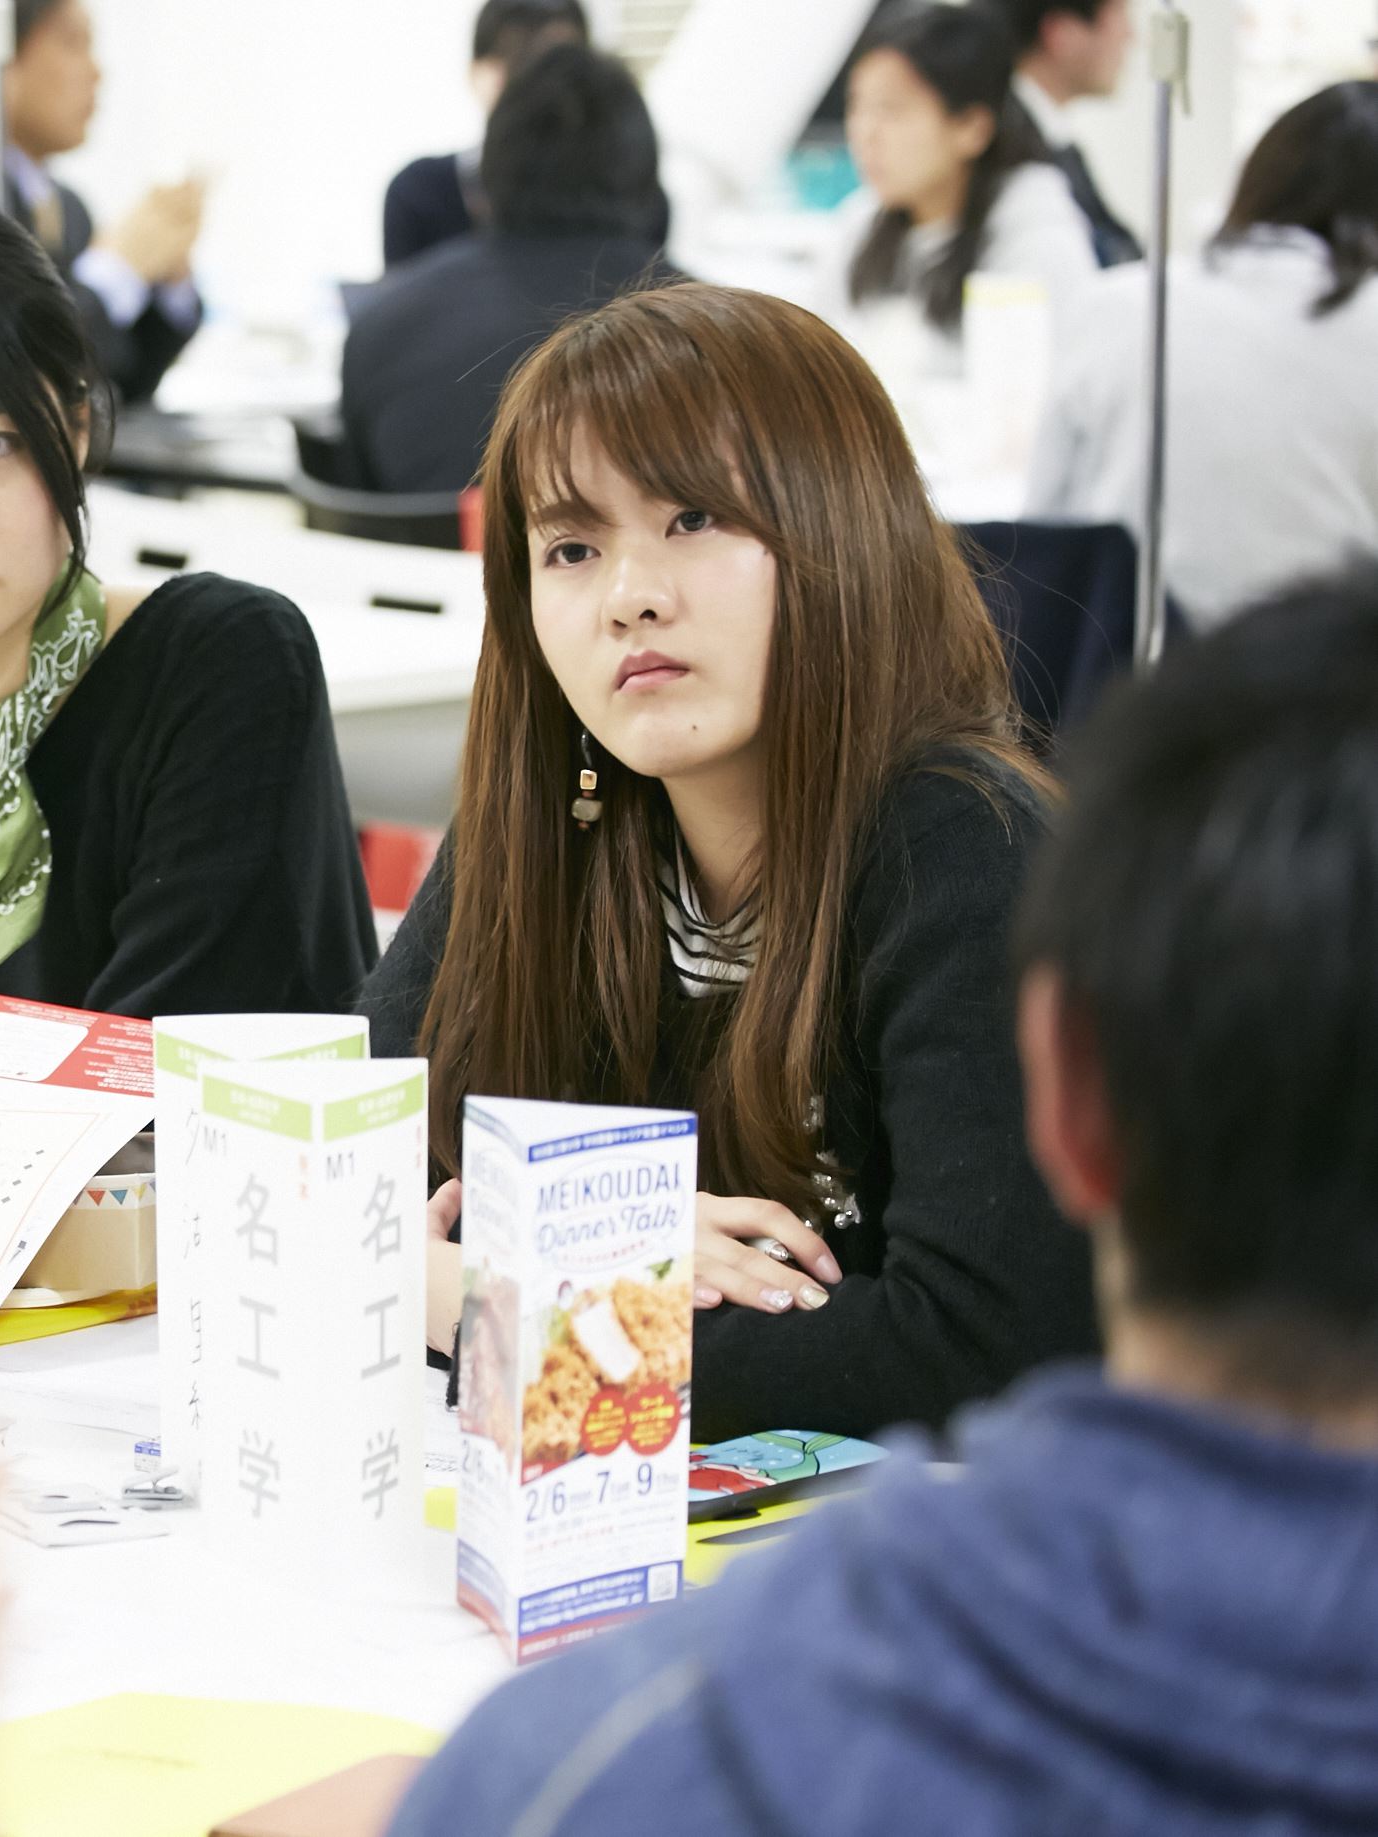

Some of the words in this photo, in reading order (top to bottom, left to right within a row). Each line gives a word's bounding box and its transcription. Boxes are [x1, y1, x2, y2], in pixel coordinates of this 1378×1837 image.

[326, 1151, 355, 1180] M1
[537, 1163, 680, 1214] MEIKOUDAI
[596, 1470, 611, 1504] 7
[636, 1461, 653, 1496] 9
